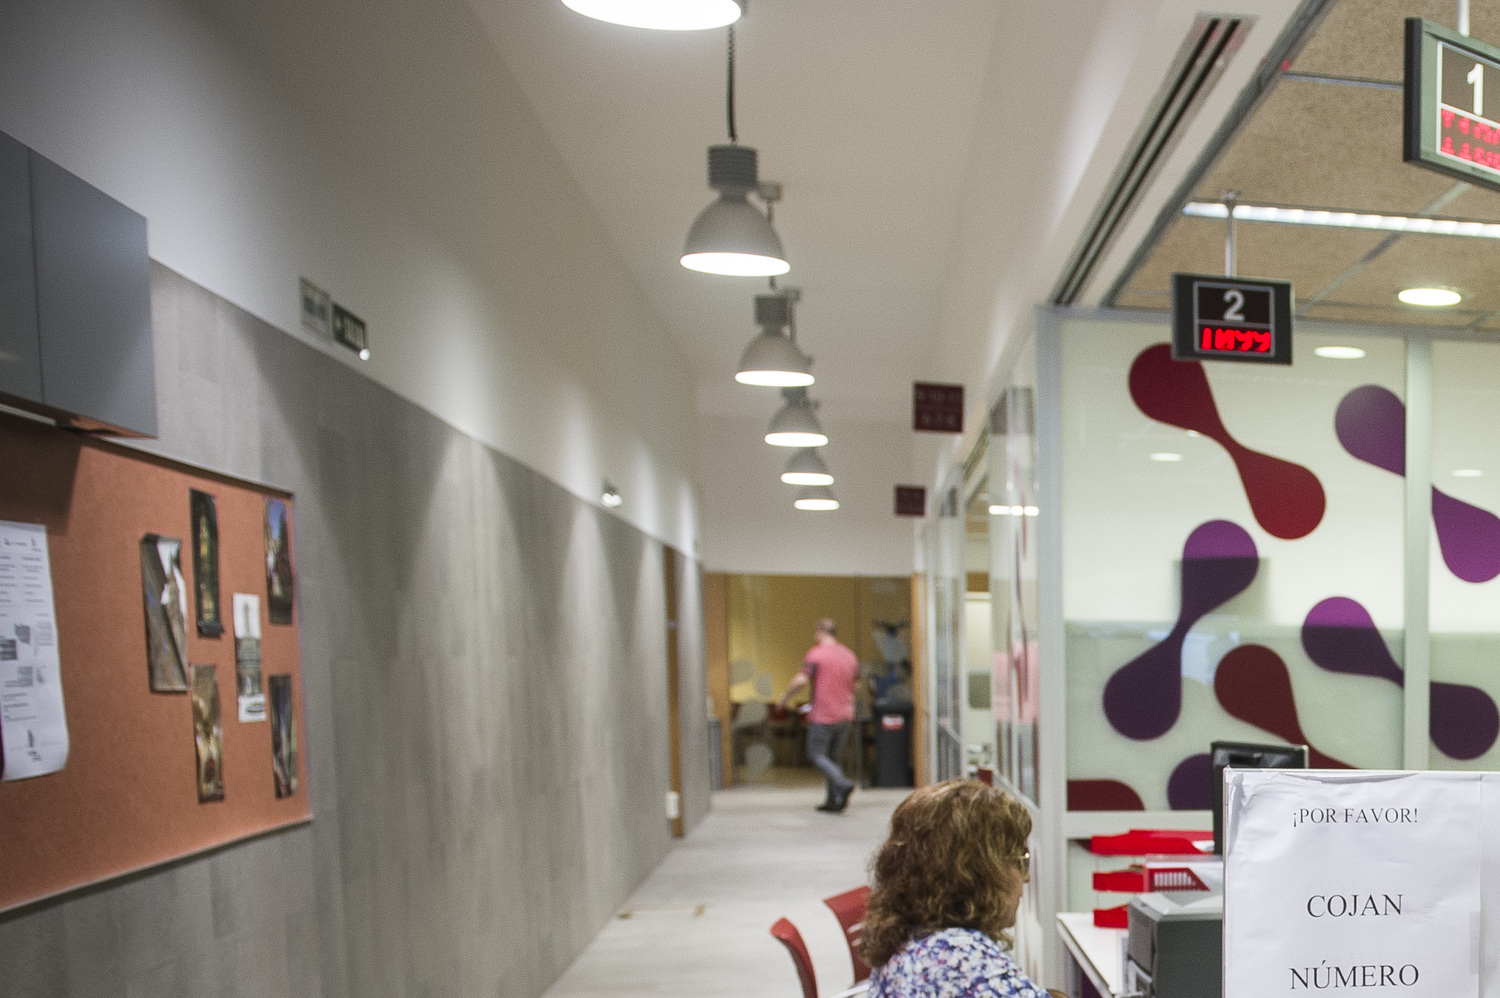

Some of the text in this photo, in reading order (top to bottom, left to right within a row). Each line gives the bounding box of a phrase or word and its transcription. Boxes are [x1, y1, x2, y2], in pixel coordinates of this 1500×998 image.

[1467, 63, 1485, 116] 1
[1223, 289, 1245, 320] 2
[1294, 808, 1417, 827] ¡POR FAVOR!
[1307, 894, 1402, 917] COJAN
[1289, 960, 1419, 989] NÚMERO
